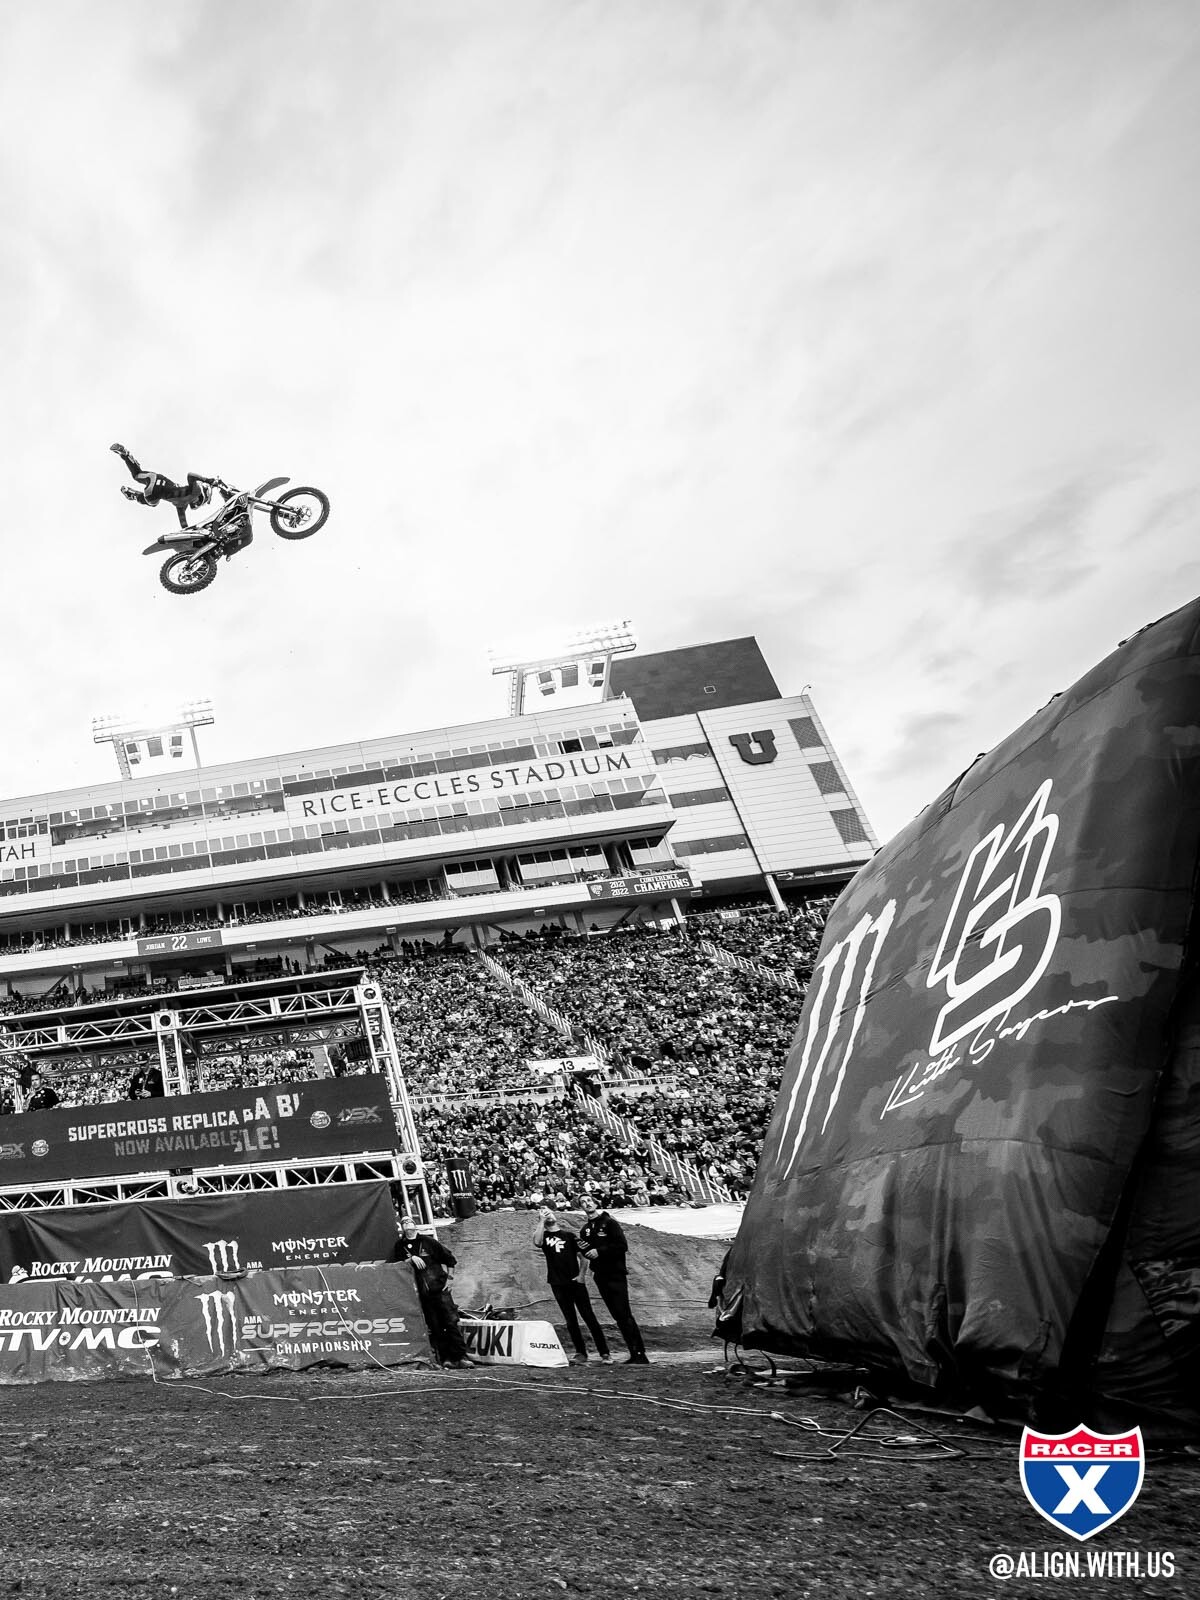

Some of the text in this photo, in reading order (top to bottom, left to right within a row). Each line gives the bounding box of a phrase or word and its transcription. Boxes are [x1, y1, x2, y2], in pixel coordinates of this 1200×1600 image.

[303, 752, 632, 817] RICE-ECCLES STADIUM
[633, 878, 690, 893] CHAMPIONS
[640, 873, 679, 883] CONFERENCE
[611, 888, 629, 896] 2022
[171, 936, 188, 950] 22
[560, 1060, 575, 1071] 13
[68, 1117, 167, 1142] SUPERCROSS
[172, 1110, 239, 1131] REPLICA
[114, 1131, 238, 1156] NOW AVAILABLE
[271, 1236, 349, 1254] MONSTER
[286, 1251, 339, 1261] ENERGY
[30, 1254, 173, 1277] ROCKY MOUNTAIN
[246, 1261, 263, 1269] AMA
[273, 1288, 361, 1308] MONSTER
[58, 1307, 161, 1325] MOUNTAIN
[288, 1306, 350, 1316] ENERGY
[244, 1316, 262, 1324] AMA
[241, 1318, 406, 1339] SUPERCROSS
[276, 1340, 372, 1355] CHAMPIONSHIP
[530, 1342, 560, 1350] SUZUKI
